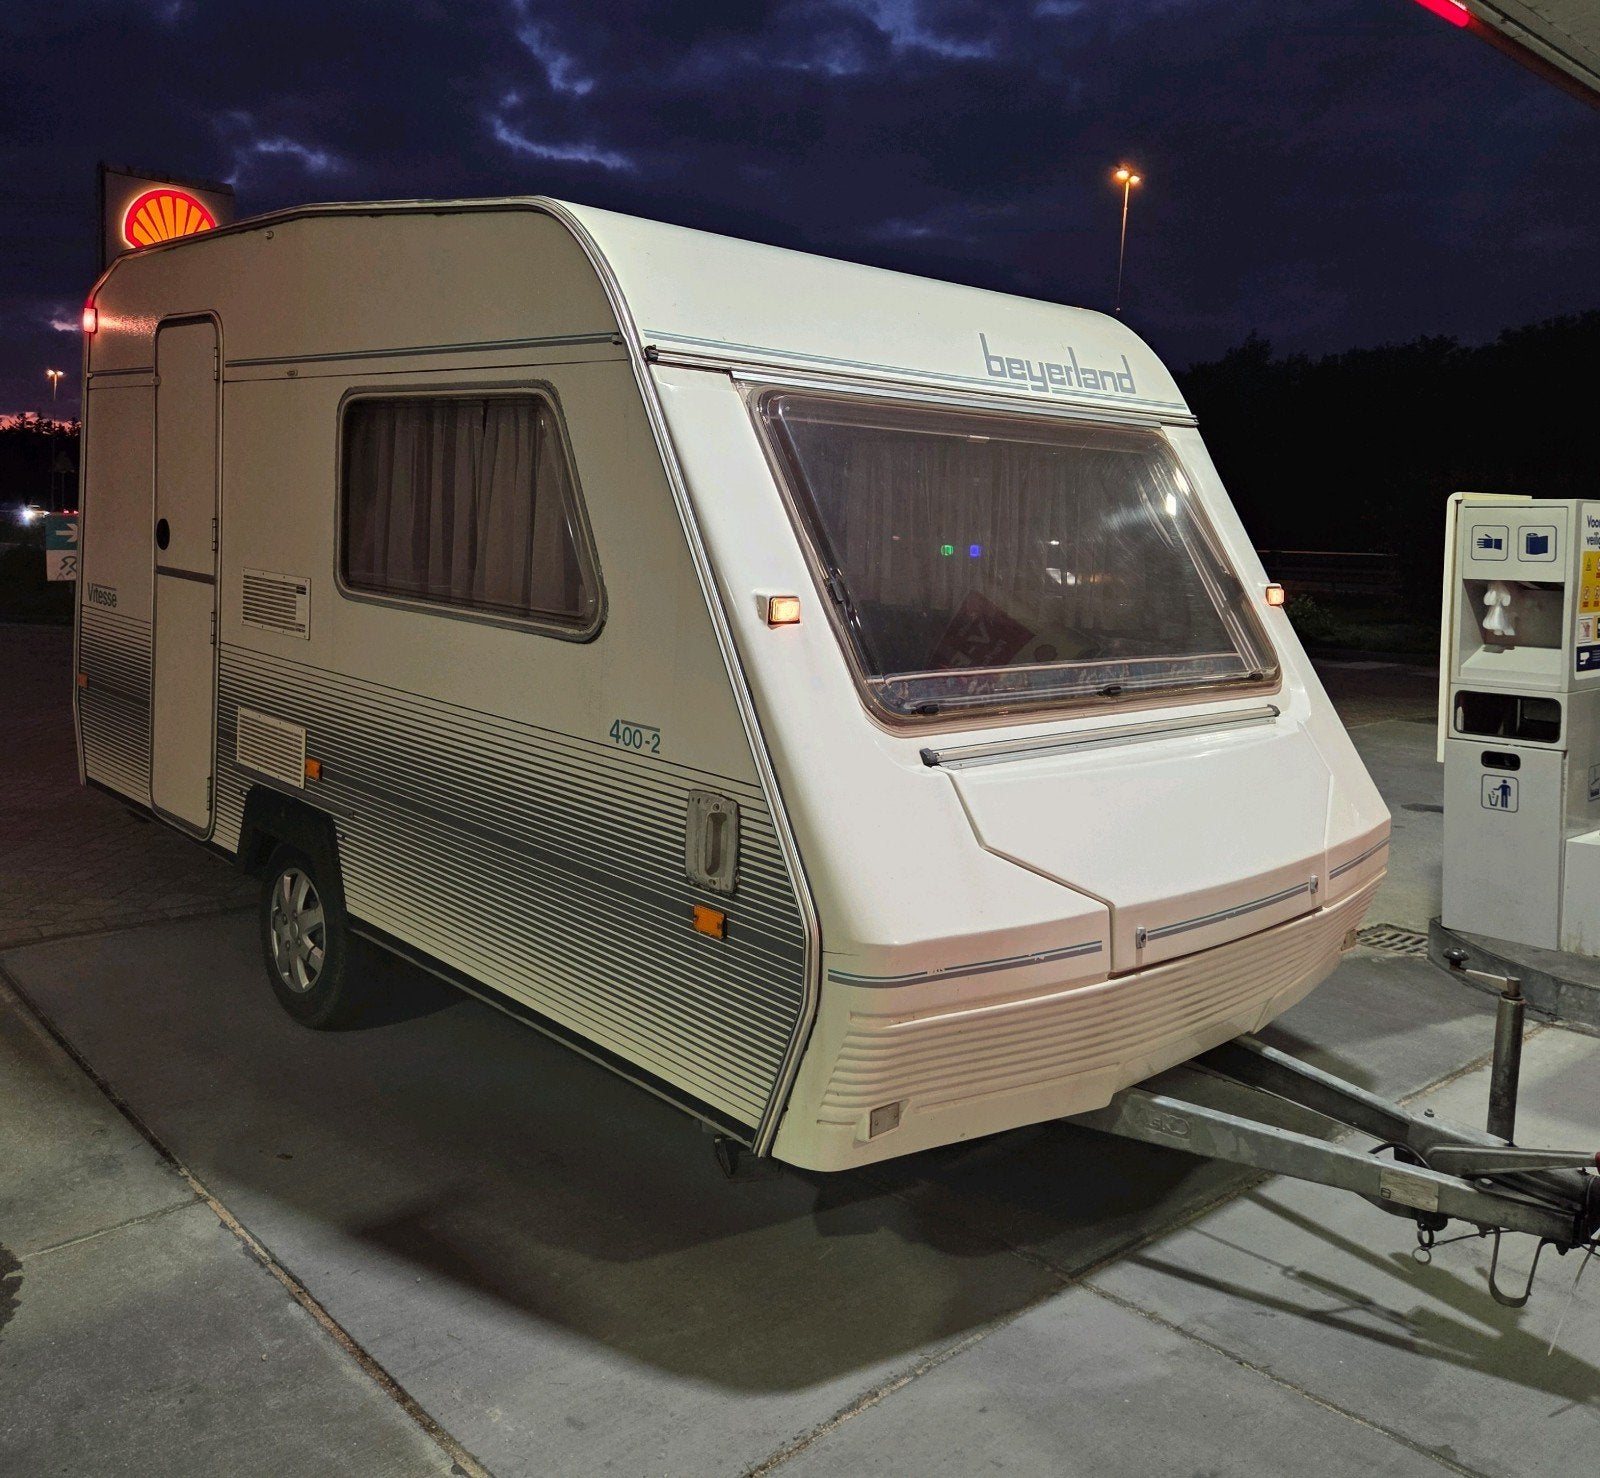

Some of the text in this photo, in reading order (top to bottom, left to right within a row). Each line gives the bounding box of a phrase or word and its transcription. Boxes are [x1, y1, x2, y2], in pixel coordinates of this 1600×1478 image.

[979, 332, 1137, 394] beyerland
[87, 582, 117, 608] Vitesse
[609, 718, 661, 754] 400-2
